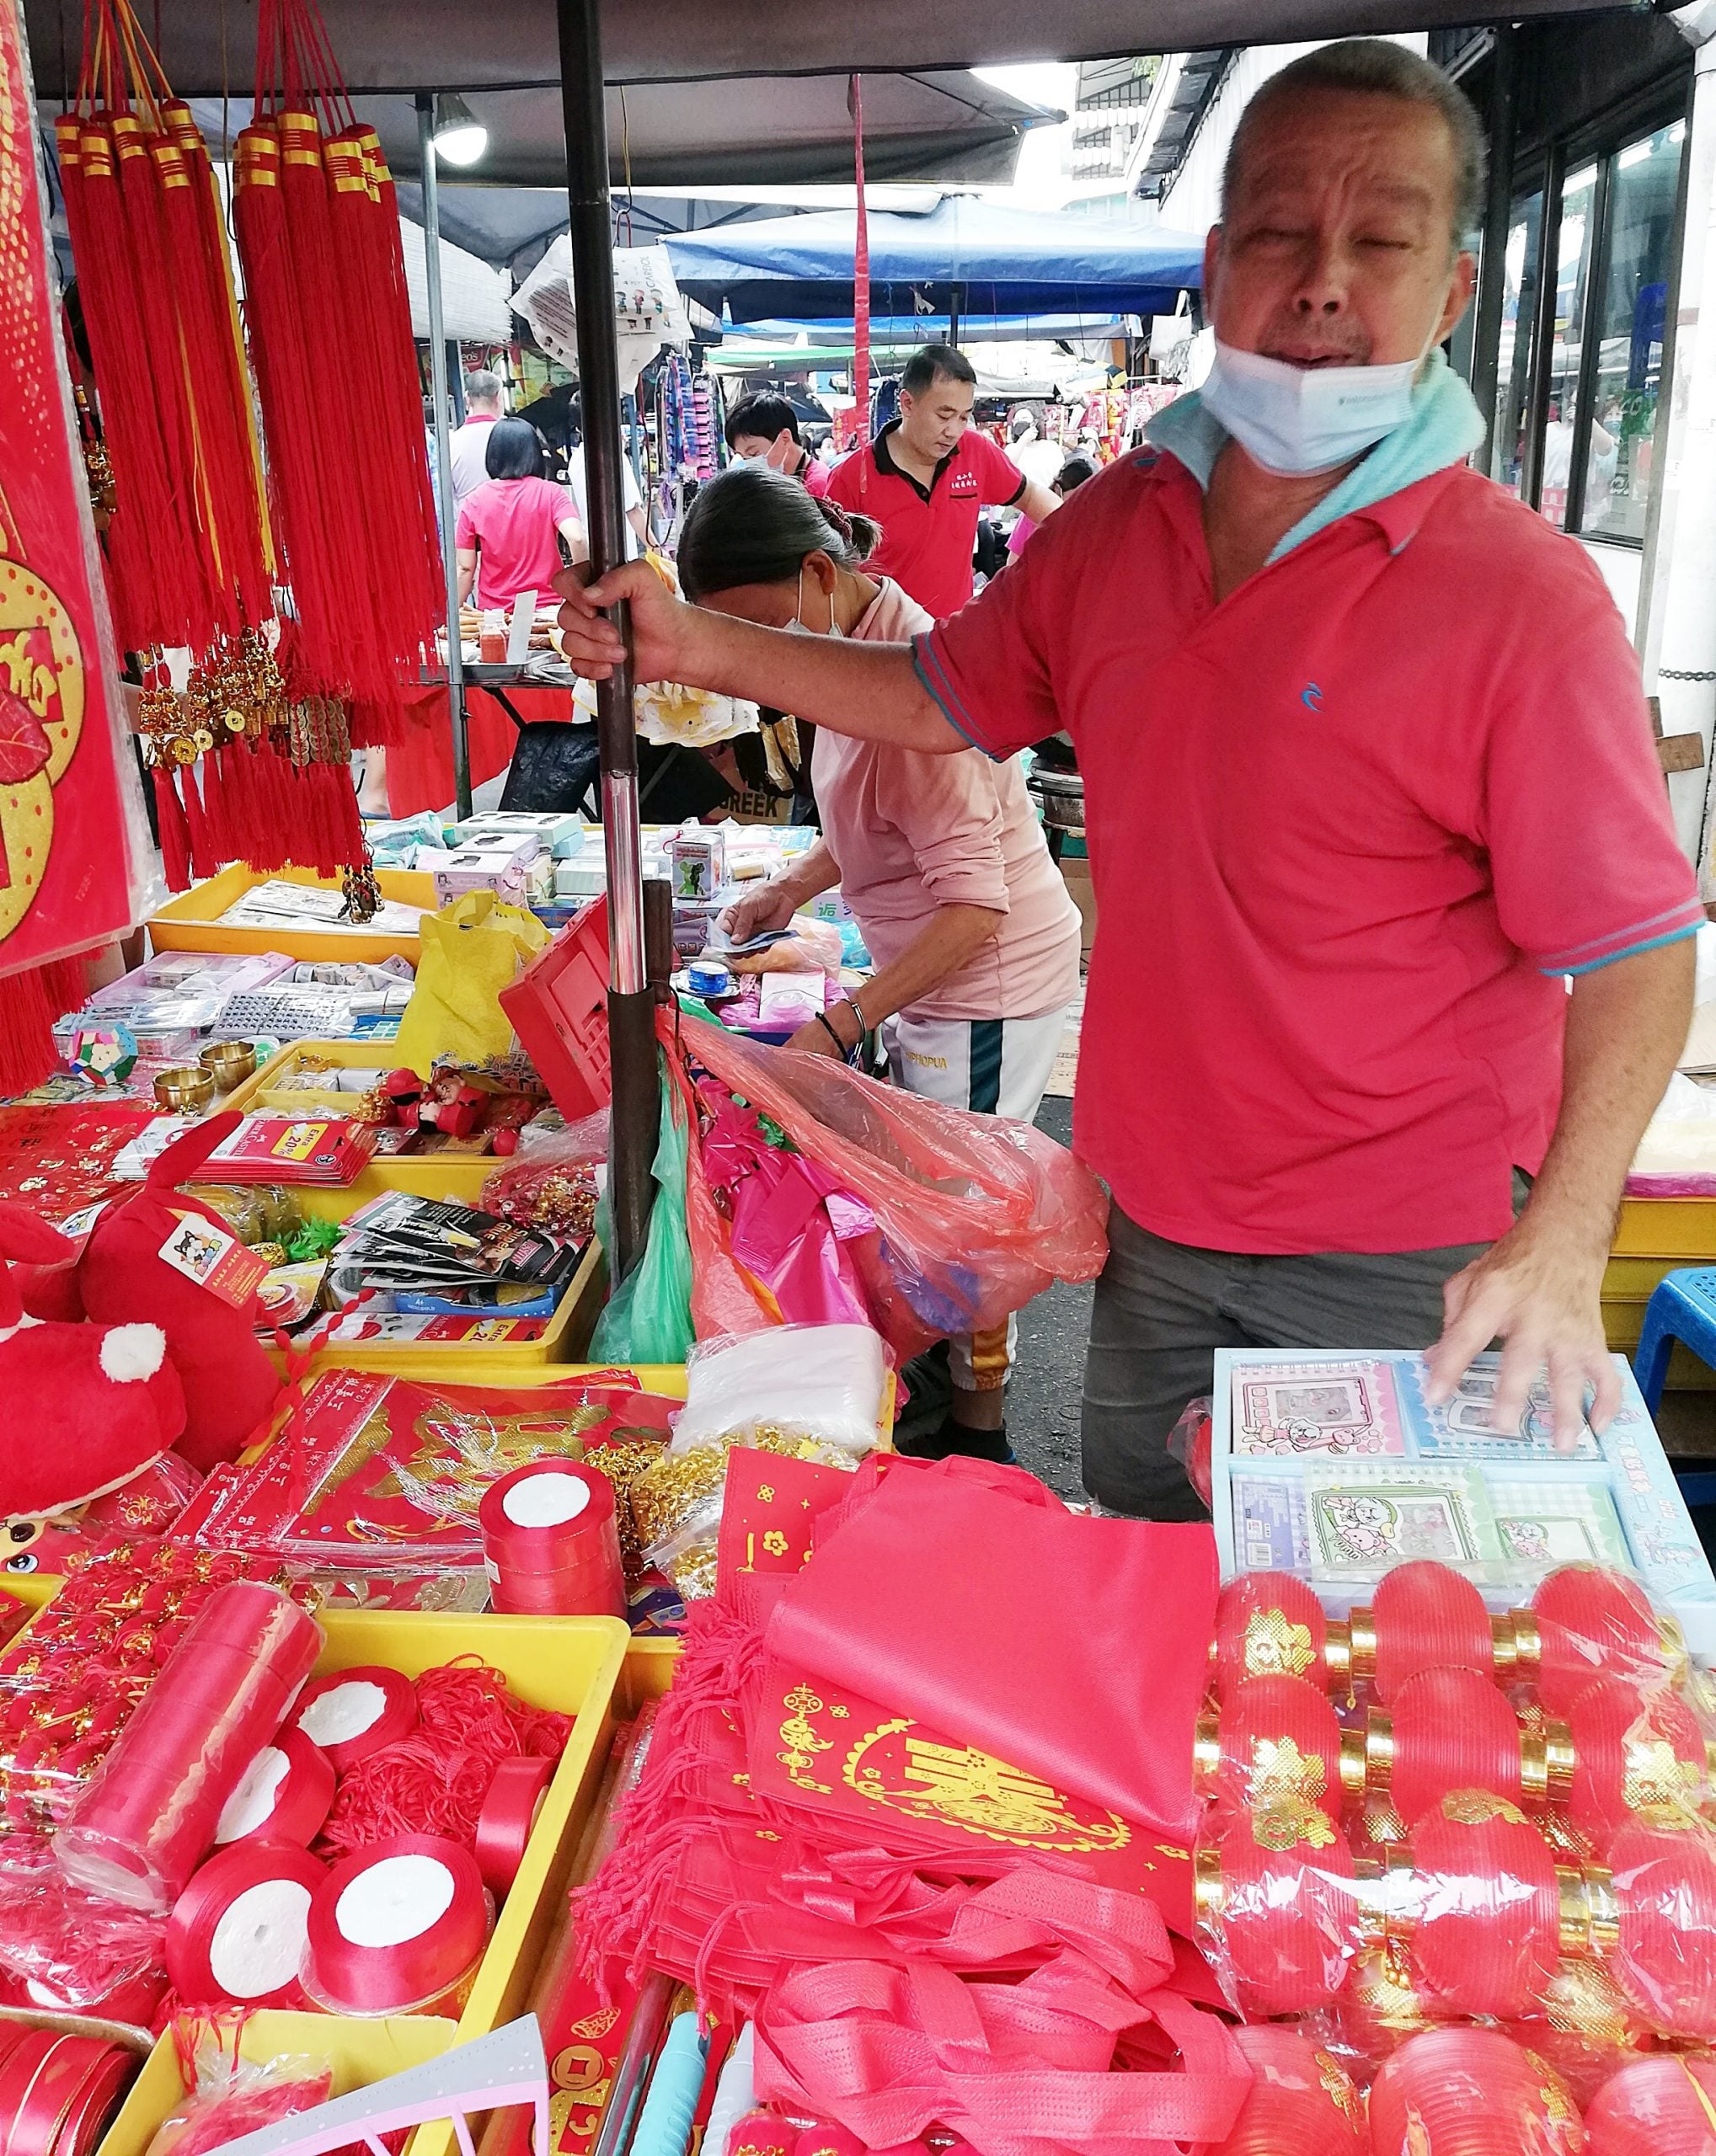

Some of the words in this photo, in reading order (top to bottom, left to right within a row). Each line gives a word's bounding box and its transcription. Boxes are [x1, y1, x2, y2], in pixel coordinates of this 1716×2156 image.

[276, 1134, 302, 1157] 20%
[302, 1128, 320, 1147] Extra
[483, 1221, 513, 1241] Glue
[495, 1227, 528, 1253] Super
[486, 1323, 509, 1341] Extra
